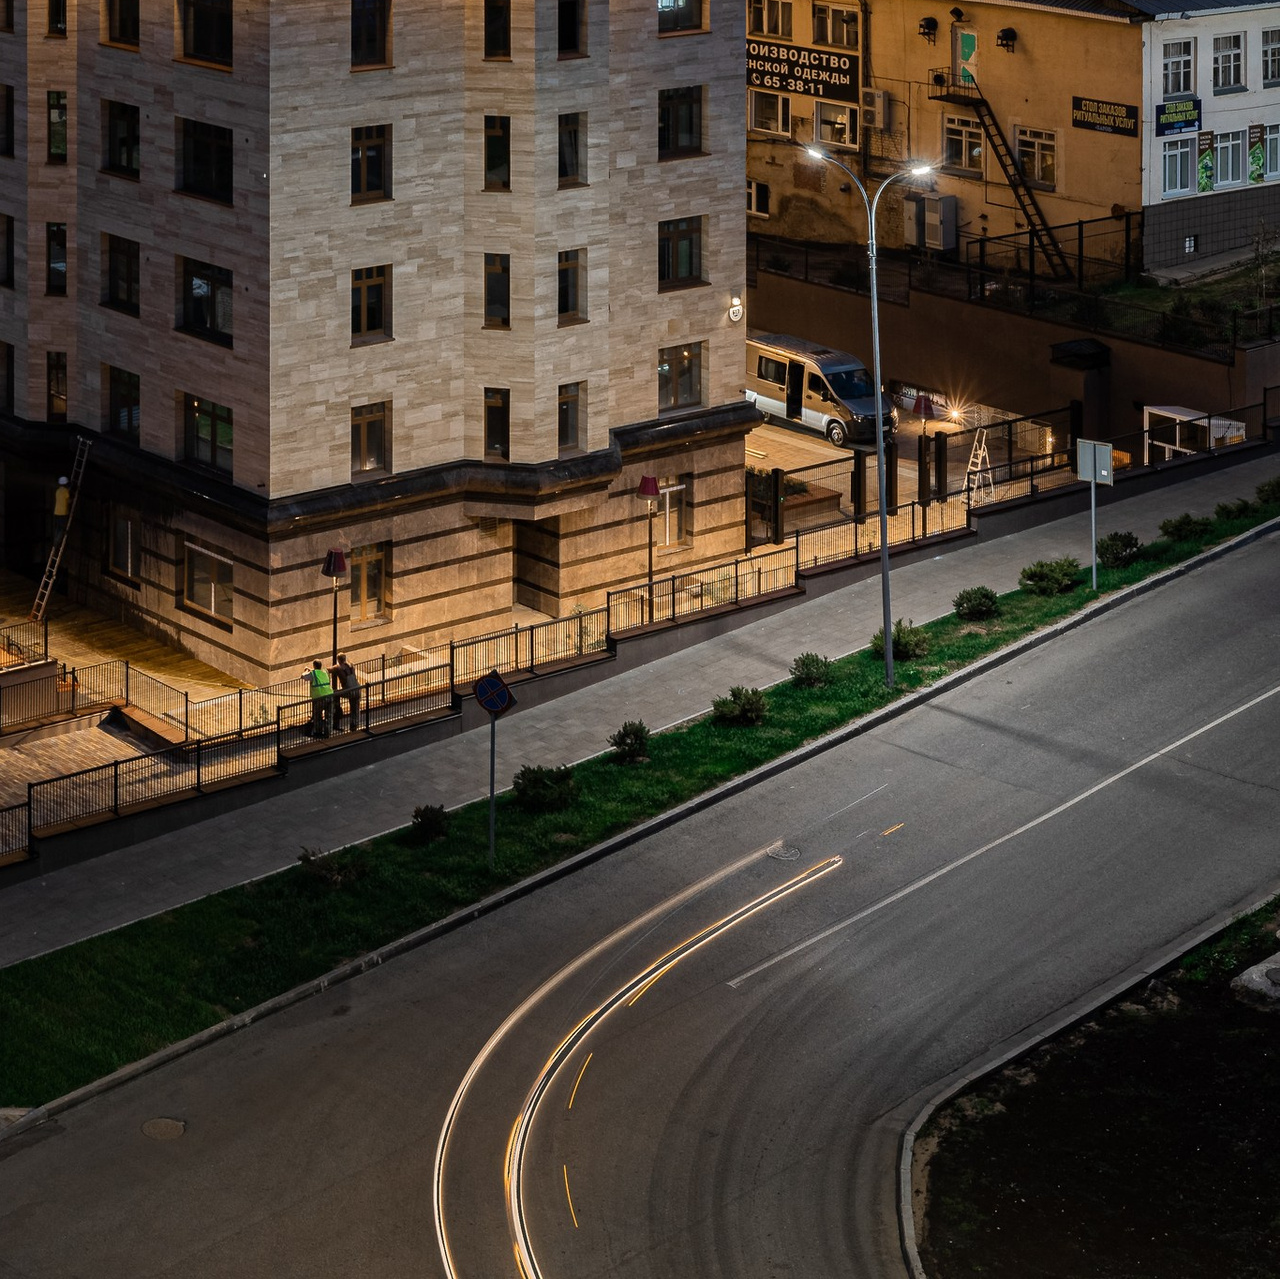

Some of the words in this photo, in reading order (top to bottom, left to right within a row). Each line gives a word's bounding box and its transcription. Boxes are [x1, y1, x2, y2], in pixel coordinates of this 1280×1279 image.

[746, 43, 850, 70] ОИЗВОДСТВО
[794, 66, 850, 85] ОДЕЖДЫ
[1081, 100, 1098, 112] СТОЛ
[1098, 103, 1127, 117] ЗАКАЗОВ
[1073, 110, 1114, 126] РИТУАЛЬНЫХ
[1114, 116, 1136, 130] УСЛУГ
